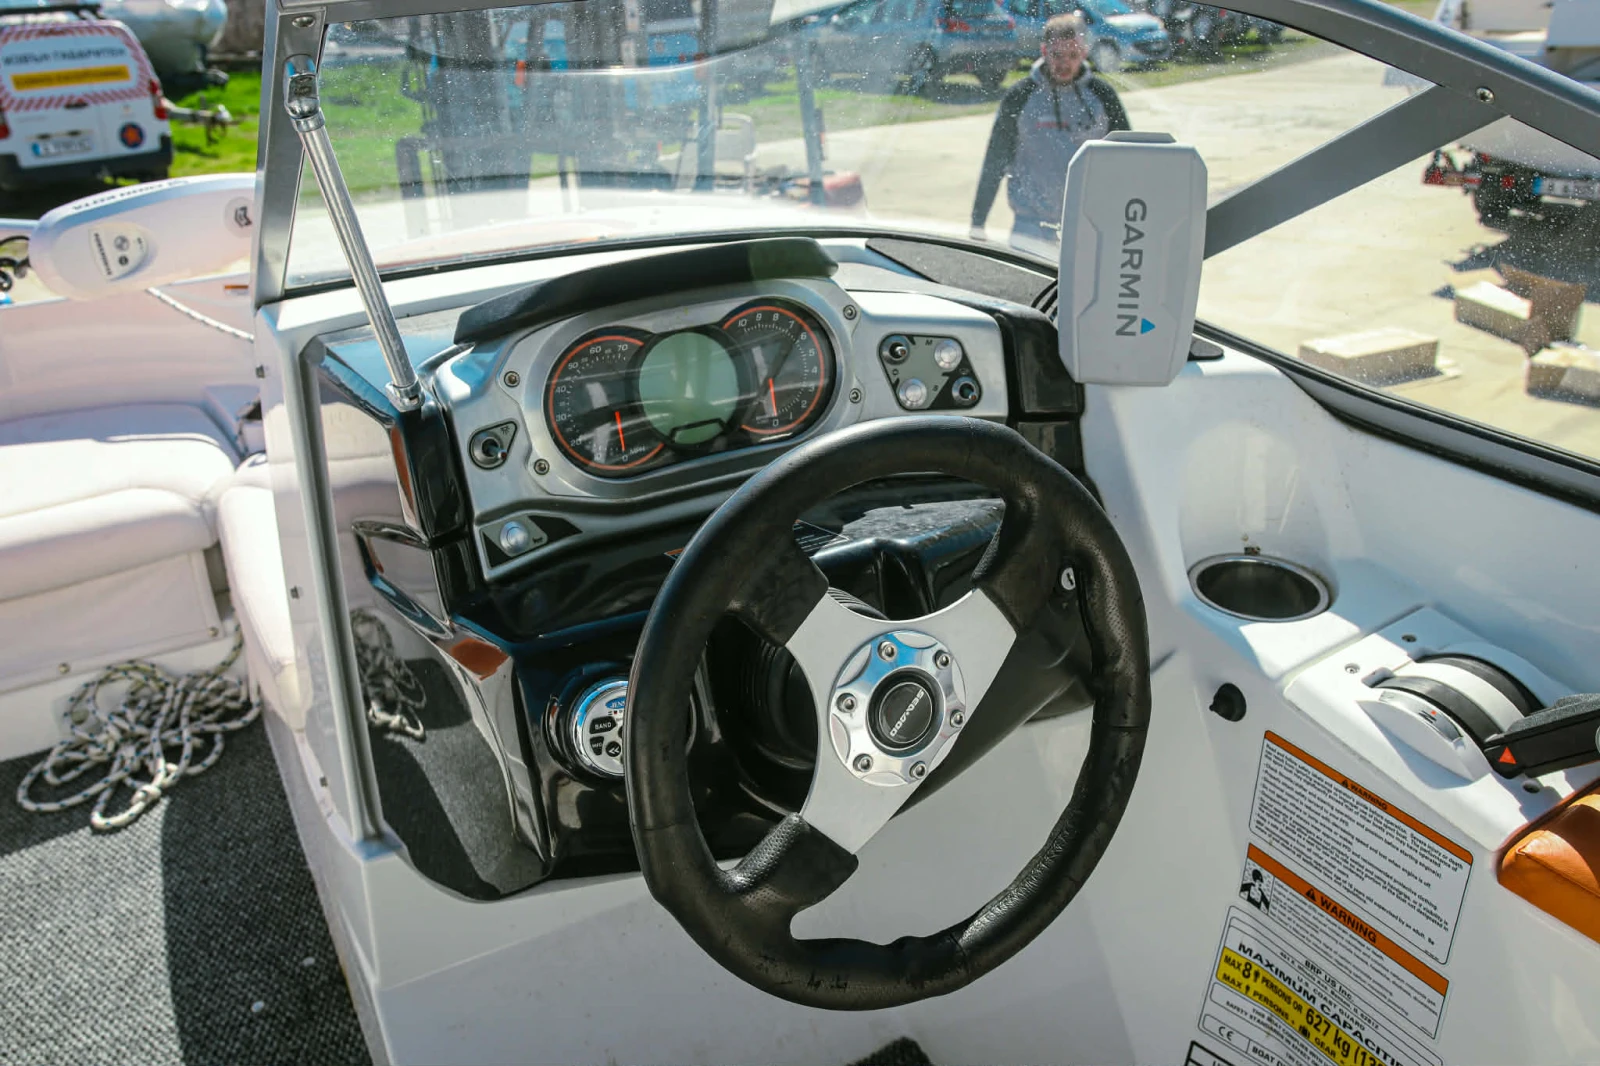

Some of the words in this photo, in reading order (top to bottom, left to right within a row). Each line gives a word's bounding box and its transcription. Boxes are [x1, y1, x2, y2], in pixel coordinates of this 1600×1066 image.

[1116, 198, 1147, 336] GARMIN
[756, 312, 762, 321] 9
[772, 312, 780, 321] 8
[738, 318, 748, 327] 10
[788, 320, 794, 328] 7
[800, 332, 807, 340] 6
[590, 346, 602, 354] 60
[618, 344, 628, 352] 70
[808, 348, 815, 356] 5
[568, 362, 578, 370] 50
[811, 366, 818, 374] 4
[800, 400, 807, 408] 2
[772, 418, 779, 427] 0
[622, 454, 628, 462] 0
[594, 722, 612, 730] BAND
[1349, 784, 1388, 810] WARNING
[1320, 895, 1378, 944] WARNING
[1238, 943, 1317, 1005] MAXIMUM
[1304, 960, 1322, 975] BRP
[1324, 974, 1336, 988] US
[1224, 956, 1242, 970] MAX
[1242, 962, 1252, 978] 8
[1261, 976, 1292, 1006] PERSONS
[1292, 1000, 1303, 1014] OR
[1306, 1008, 1330, 1036] 627
[1334, 1029, 1350, 1058] kg
[1222, 973, 1242, 989] MAX
[1252, 990, 1289, 1020] PERSONS
[1315, 1037, 1336, 1058] GEAR
[1218, 1026, 1234, 1041] CE
[1252, 1046, 1275, 1063] BOAT
